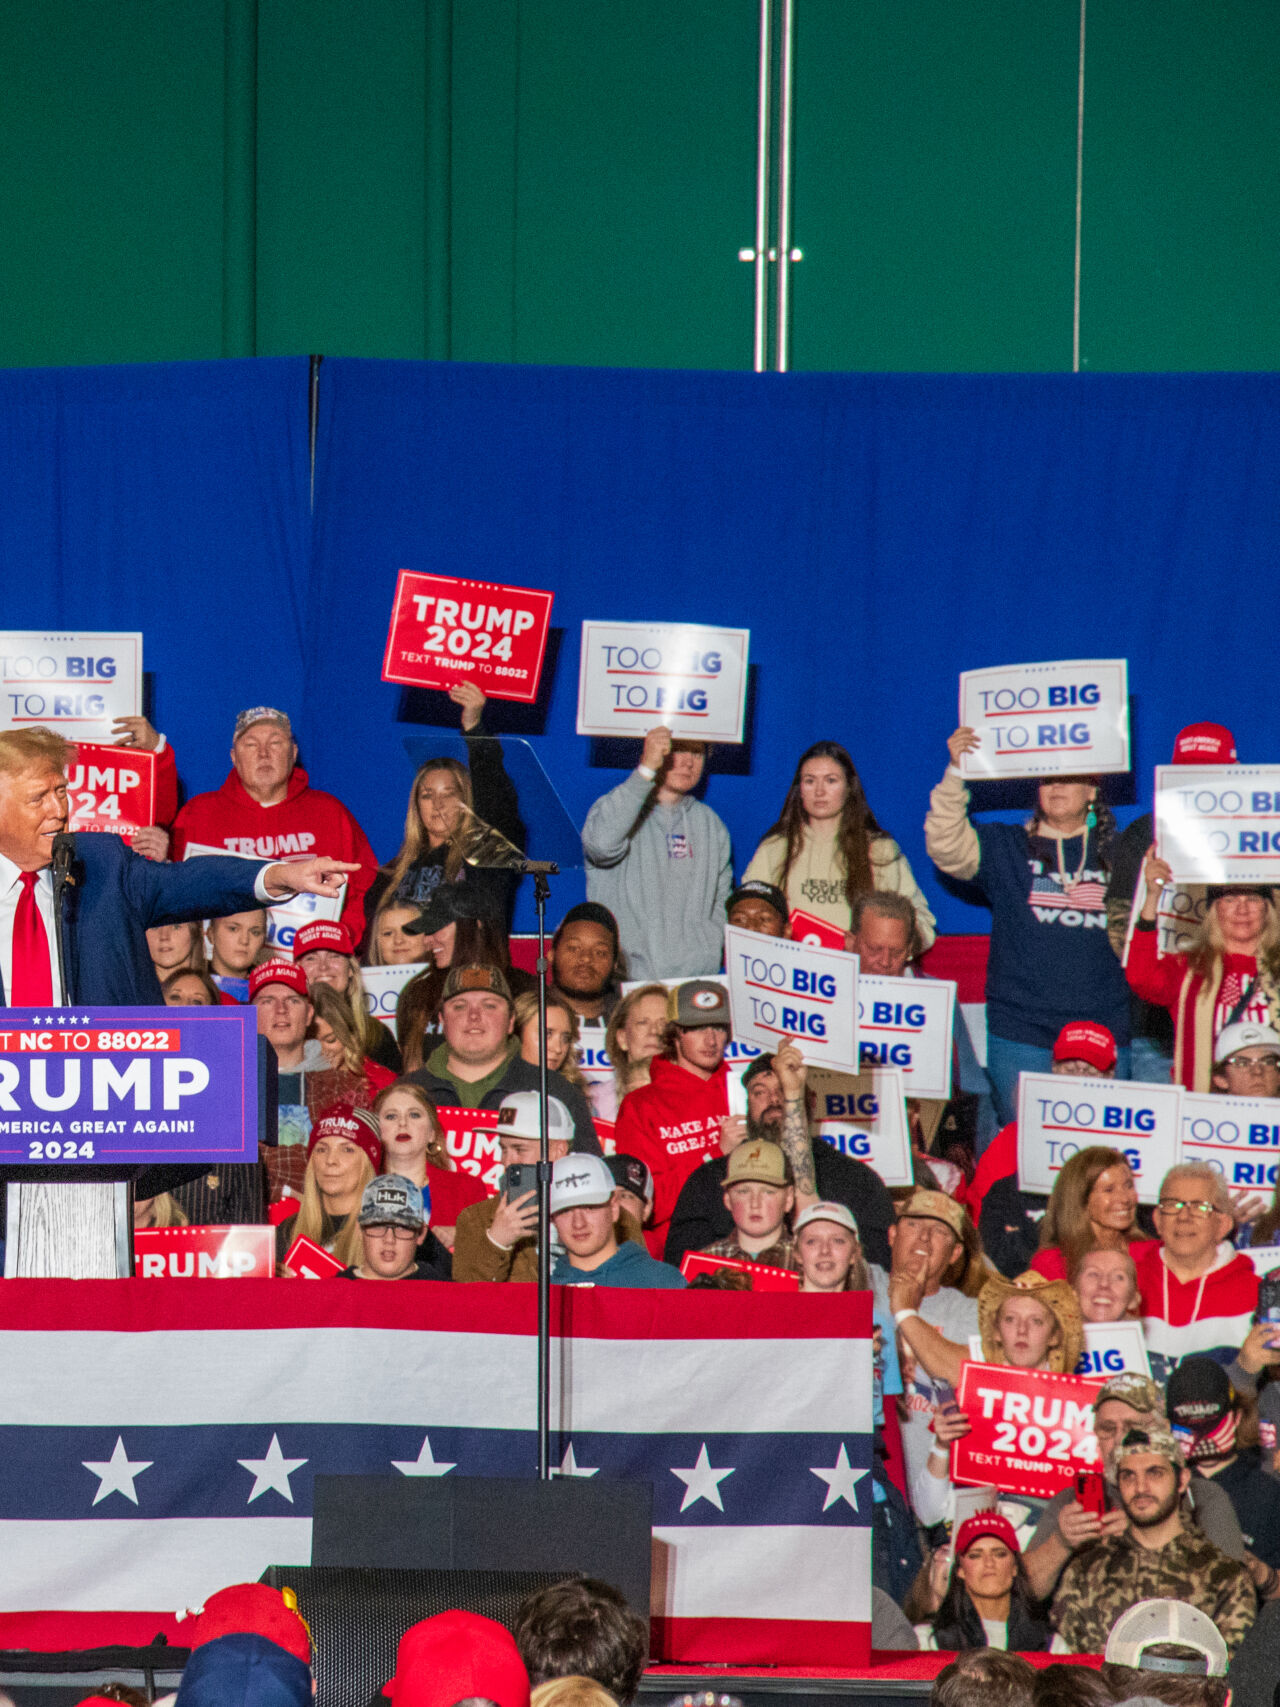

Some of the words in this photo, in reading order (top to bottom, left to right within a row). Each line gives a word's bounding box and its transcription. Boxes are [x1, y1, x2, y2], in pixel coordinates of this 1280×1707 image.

[413, 595, 535, 636] TRUMP
[423, 625, 513, 662] 2024
[65, 656, 117, 679] BIG
[400, 650, 431, 666] TEXT
[434, 656, 475, 672] TRUMP
[478, 662, 493, 674] TO
[495, 666, 528, 679] 88022
[601, 645, 662, 669] TOO
[8, 693, 46, 716] TO
[53, 693, 105, 716] RIG
[610, 684, 648, 707] TO
[978, 687, 1040, 711] TOO
[1048, 683, 1100, 707] BIG
[991, 725, 1029, 749] TO
[1037, 722, 1091, 746] RIG
[66, 764, 140, 794] UMP
[1251, 791, 1280, 813] BI
[83, 823, 100, 834] TO
[222, 831, 316, 858] TRUMP
[801, 886, 847, 897] LOVES
[807, 894, 839, 905] YOU
[1032, 906, 1108, 929] WON
[302, 933, 321, 945] GREAT
[315, 925, 342, 936] AMERICA
[275, 967, 297, 979] AGAIN
[740, 954, 786, 987] TOO
[792, 968, 837, 998] BIG
[749, 996, 776, 1025] TO
[782, 1006, 825, 1036] RIG
[873, 1002, 926, 1026] BIG
[20, 1032, 53, 1050] NC
[60, 1032, 90, 1050] TO
[97, 1031, 169, 1050] 88022
[859, 1041, 912, 1066] RIG
[825, 1093, 879, 1116] BIG
[1038, 1099, 1095, 1126] TOO
[1103, 1106, 1156, 1131] BIG
[70, 1121, 127, 1134] GREAT
[133, 1120, 195, 1133] AGAIN!
[319, 1117, 359, 1131] TRUMP
[659, 1119, 703, 1140] MAKE
[1249, 1124, 1280, 1146] BI
[28, 1141, 95, 1160] 2024
[666, 1131, 720, 1156] GREAT
[377, 1191, 405, 1203] Huk
[136, 1252, 257, 1278] RUMP
[1074, 1350, 1125, 1375] BIG
[977, 1388, 1097, 1431] TRUM
[1173, 1403, 1219, 1417] TRUMP
[992, 1422, 1099, 1465] 2024
[968, 1451, 1001, 1466] TEXT
[1005, 1457, 1053, 1473] TRUMP
[1057, 1465, 1074, 1477] TO
